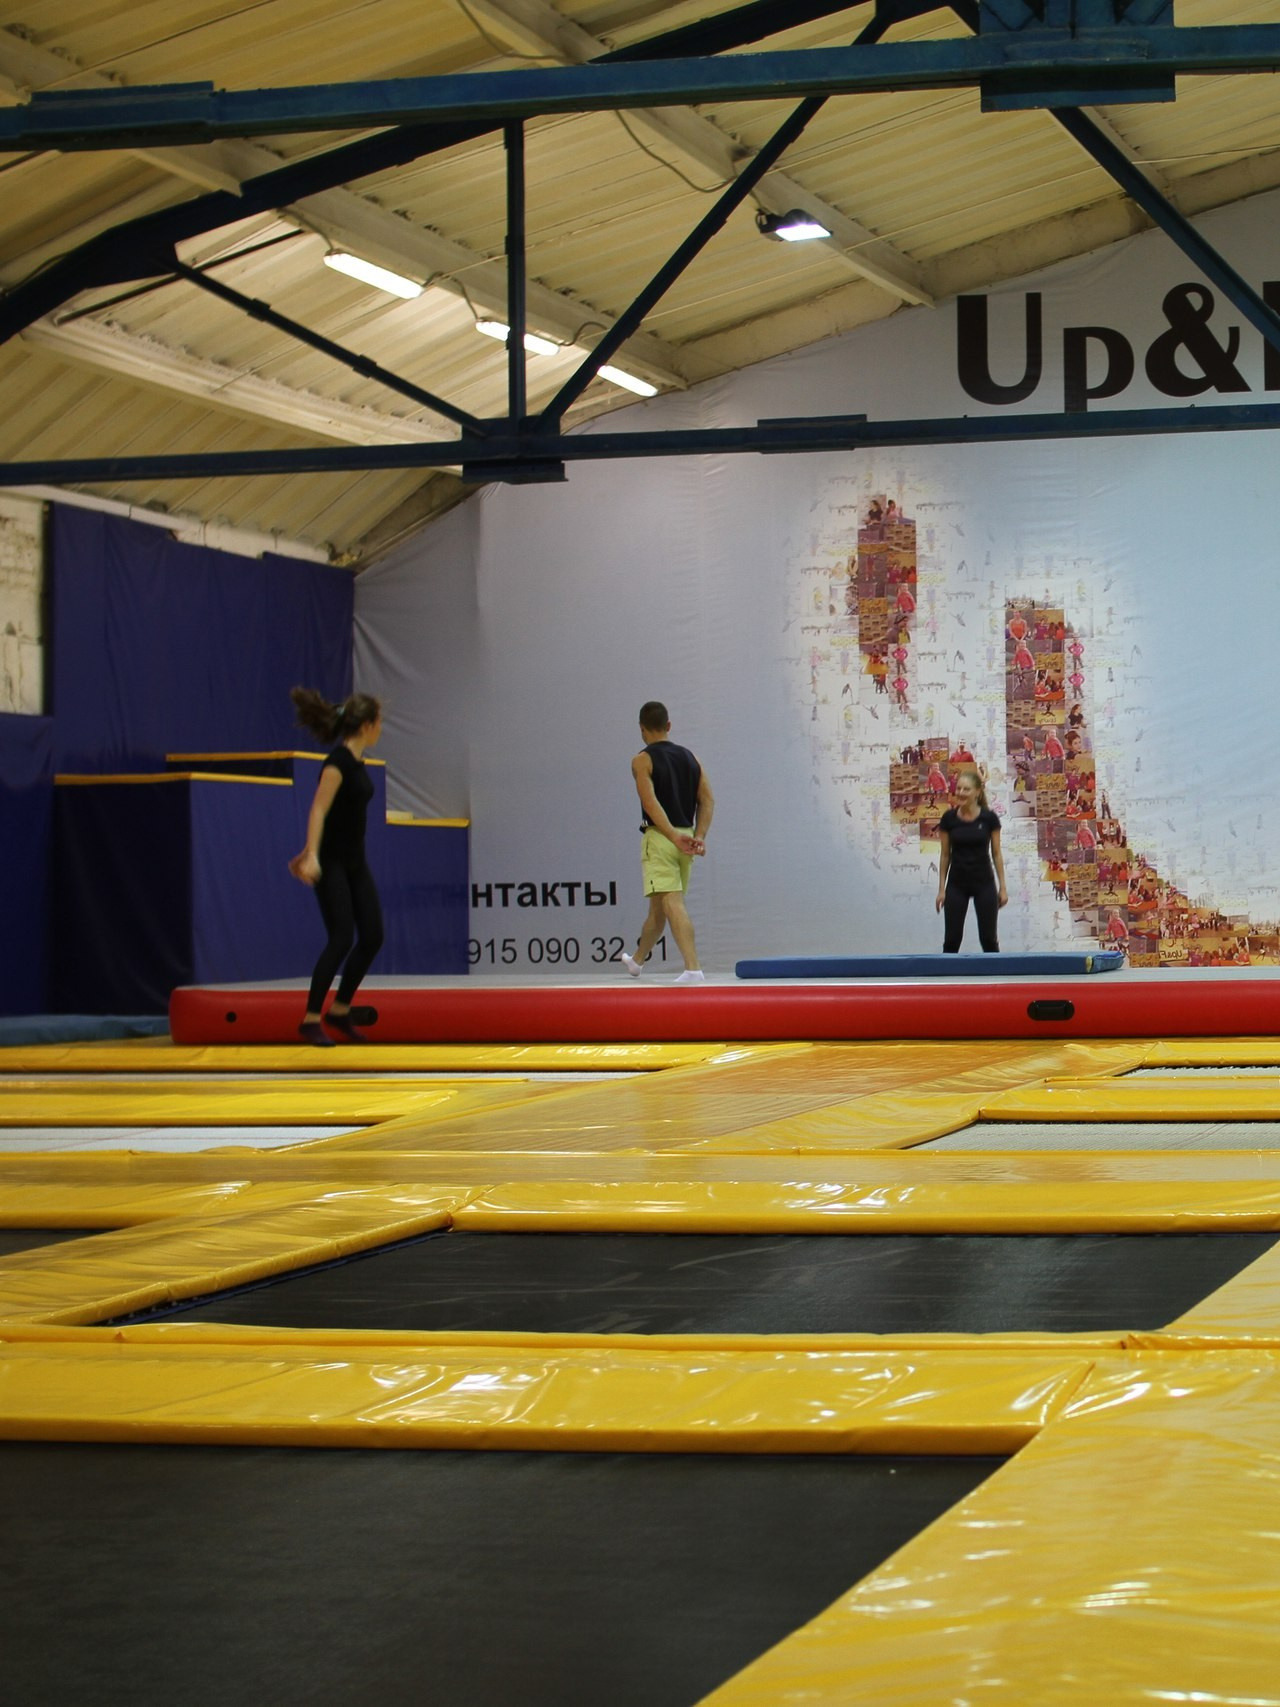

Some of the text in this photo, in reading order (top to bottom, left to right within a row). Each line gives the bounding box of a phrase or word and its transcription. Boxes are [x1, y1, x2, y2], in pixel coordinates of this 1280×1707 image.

[467, 938, 518, 965] 915
[527, 937, 581, 964] 090
[590, 936, 625, 964] 32
